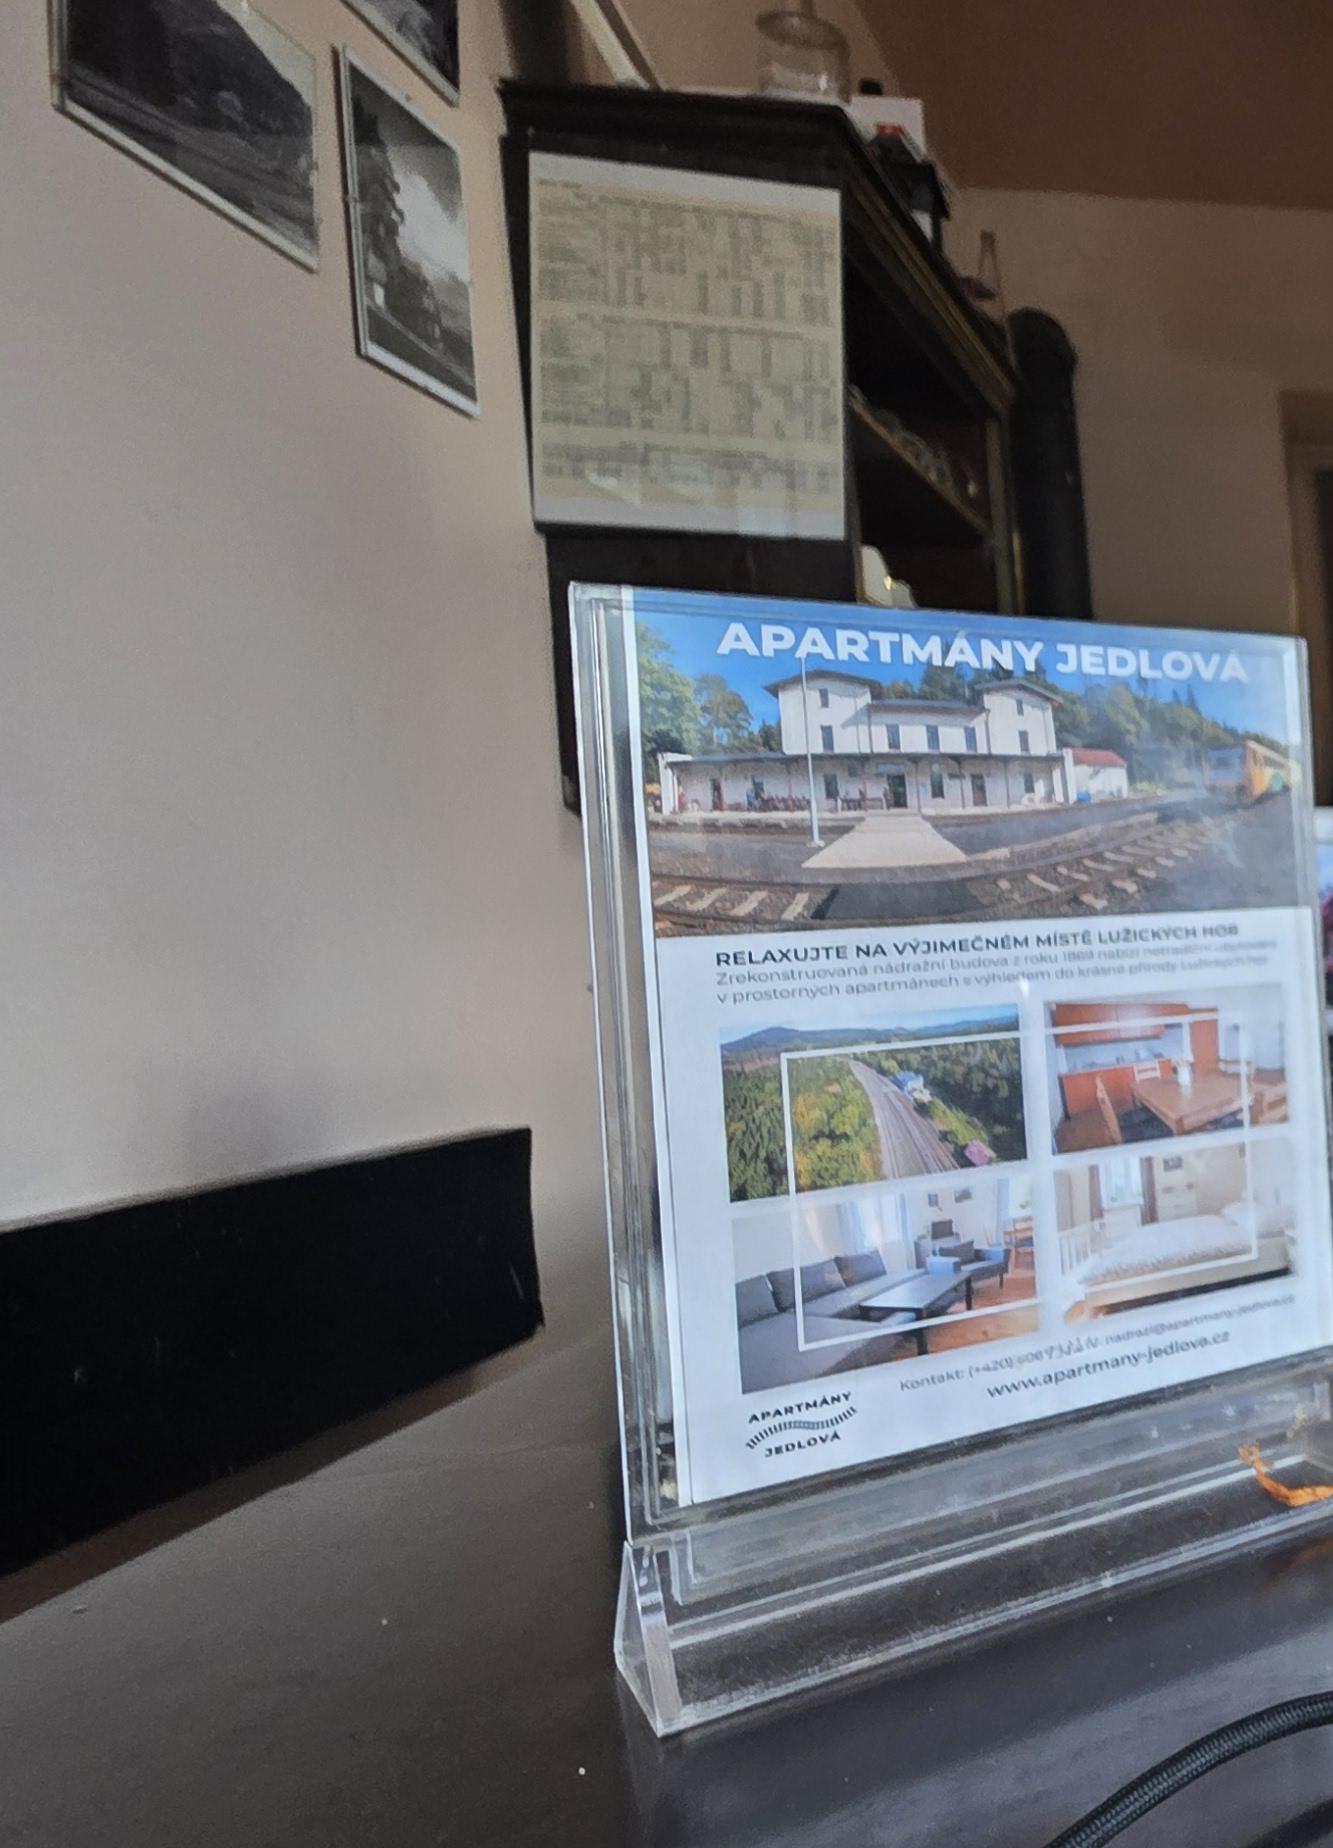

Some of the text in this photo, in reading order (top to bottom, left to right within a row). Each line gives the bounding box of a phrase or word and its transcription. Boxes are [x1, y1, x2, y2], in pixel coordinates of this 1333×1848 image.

[716, 622, 1249, 685] APARTMÁNY JEDLOVÁ
[715, 944, 849, 967] RELAXUJTE
[855, 942, 888, 959] NA
[892, 933, 1029, 956] VÝJIMEČNÉM
[1035, 926, 1092, 947] MÍSTĚ
[1097, 923, 1198, 945] LUŽICKÝCH
[715, 964, 869, 987] Zrekonstruovaná
[873, 957, 946, 976] nádražní
[950, 955, 1009, 970] budova
[1024, 952, 1058, 966] roku
[716, 993, 728, 1005] v
[733, 982, 841, 1006] prostorných
[845, 975, 960, 997] apartmánech
[1055, 966, 1075, 980] do
[899, 1370, 964, 1392] Kontakt:
[985, 1328, 1231, 1400] www.apartmany-jedlova.cz
[748, 1391, 852, 1424] APARTMÁNY
[764, 1429, 842, 1458] JEDLOVÁ
